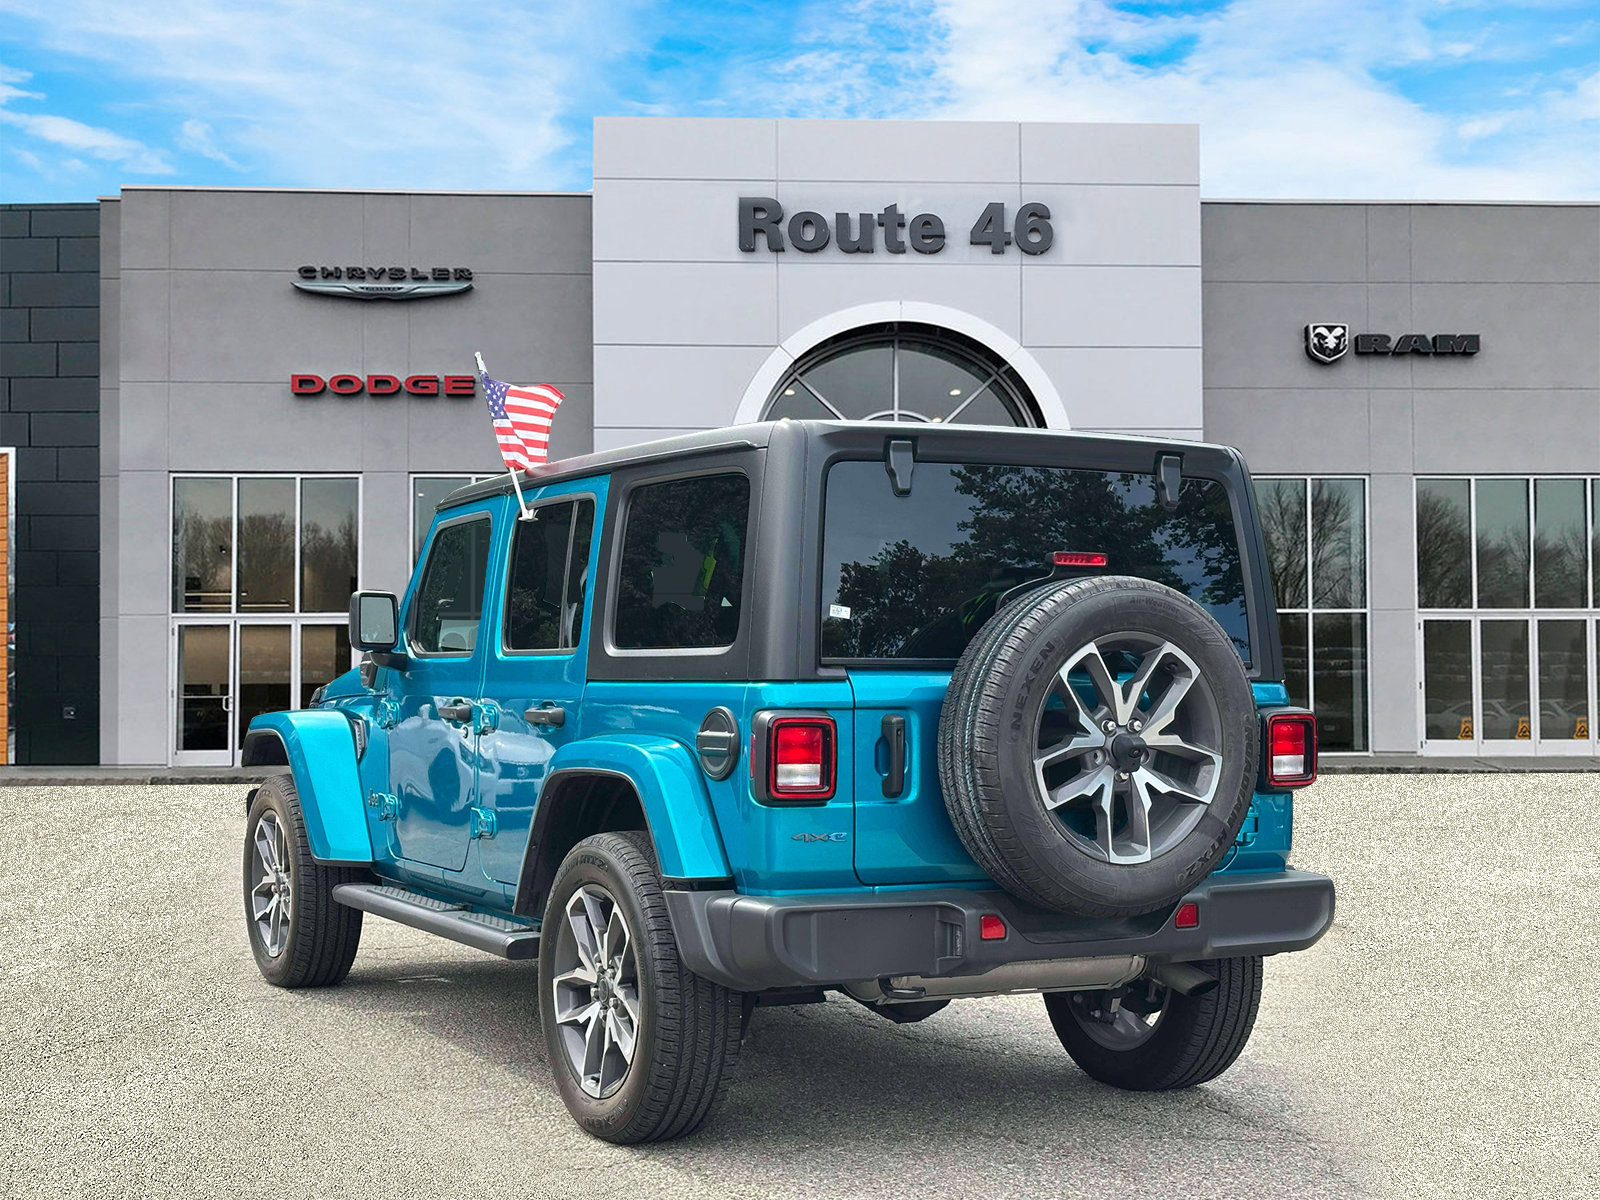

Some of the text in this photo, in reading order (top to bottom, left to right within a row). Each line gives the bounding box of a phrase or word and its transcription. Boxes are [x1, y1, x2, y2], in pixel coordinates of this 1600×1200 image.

[738, 197, 1054, 255] Route 46
[297, 266, 473, 281] CHRYSLER
[1354, 334, 1480, 355] RAM
[291, 374, 475, 396] DODGE
[1011, 640, 1057, 731] NEXEN
